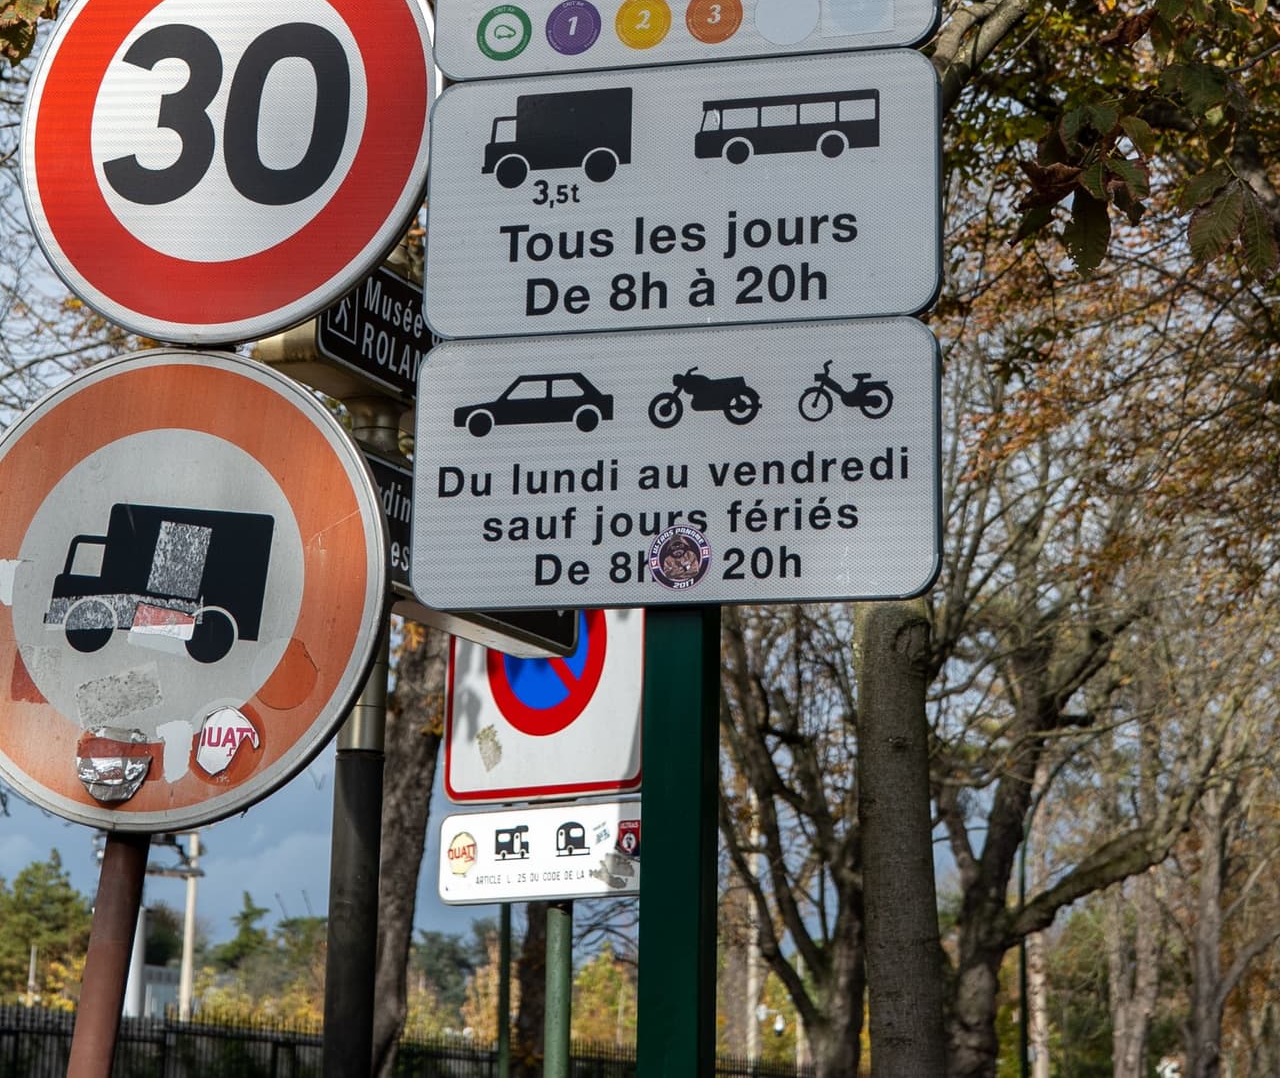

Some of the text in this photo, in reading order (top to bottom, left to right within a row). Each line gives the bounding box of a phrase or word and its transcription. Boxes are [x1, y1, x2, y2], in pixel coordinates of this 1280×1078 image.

[567, 16, 579, 36] 1
[634, 9, 652, 30] 2
[706, 4, 721, 25] 3
[102, 22, 351, 205] 30
[532, 179, 580, 209] 3,5t
[500, 211, 858, 263] Tous les jours
[364, 276, 423, 339] Musée
[525, 262, 827, 316] De 8h à 20h
[438, 447, 909, 498] Du lundi au vendredi
[482, 497, 859, 545] sauf jours fériés
[534, 546, 802, 586] De 8h 20h
[672, 578, 695, 589] 2017
